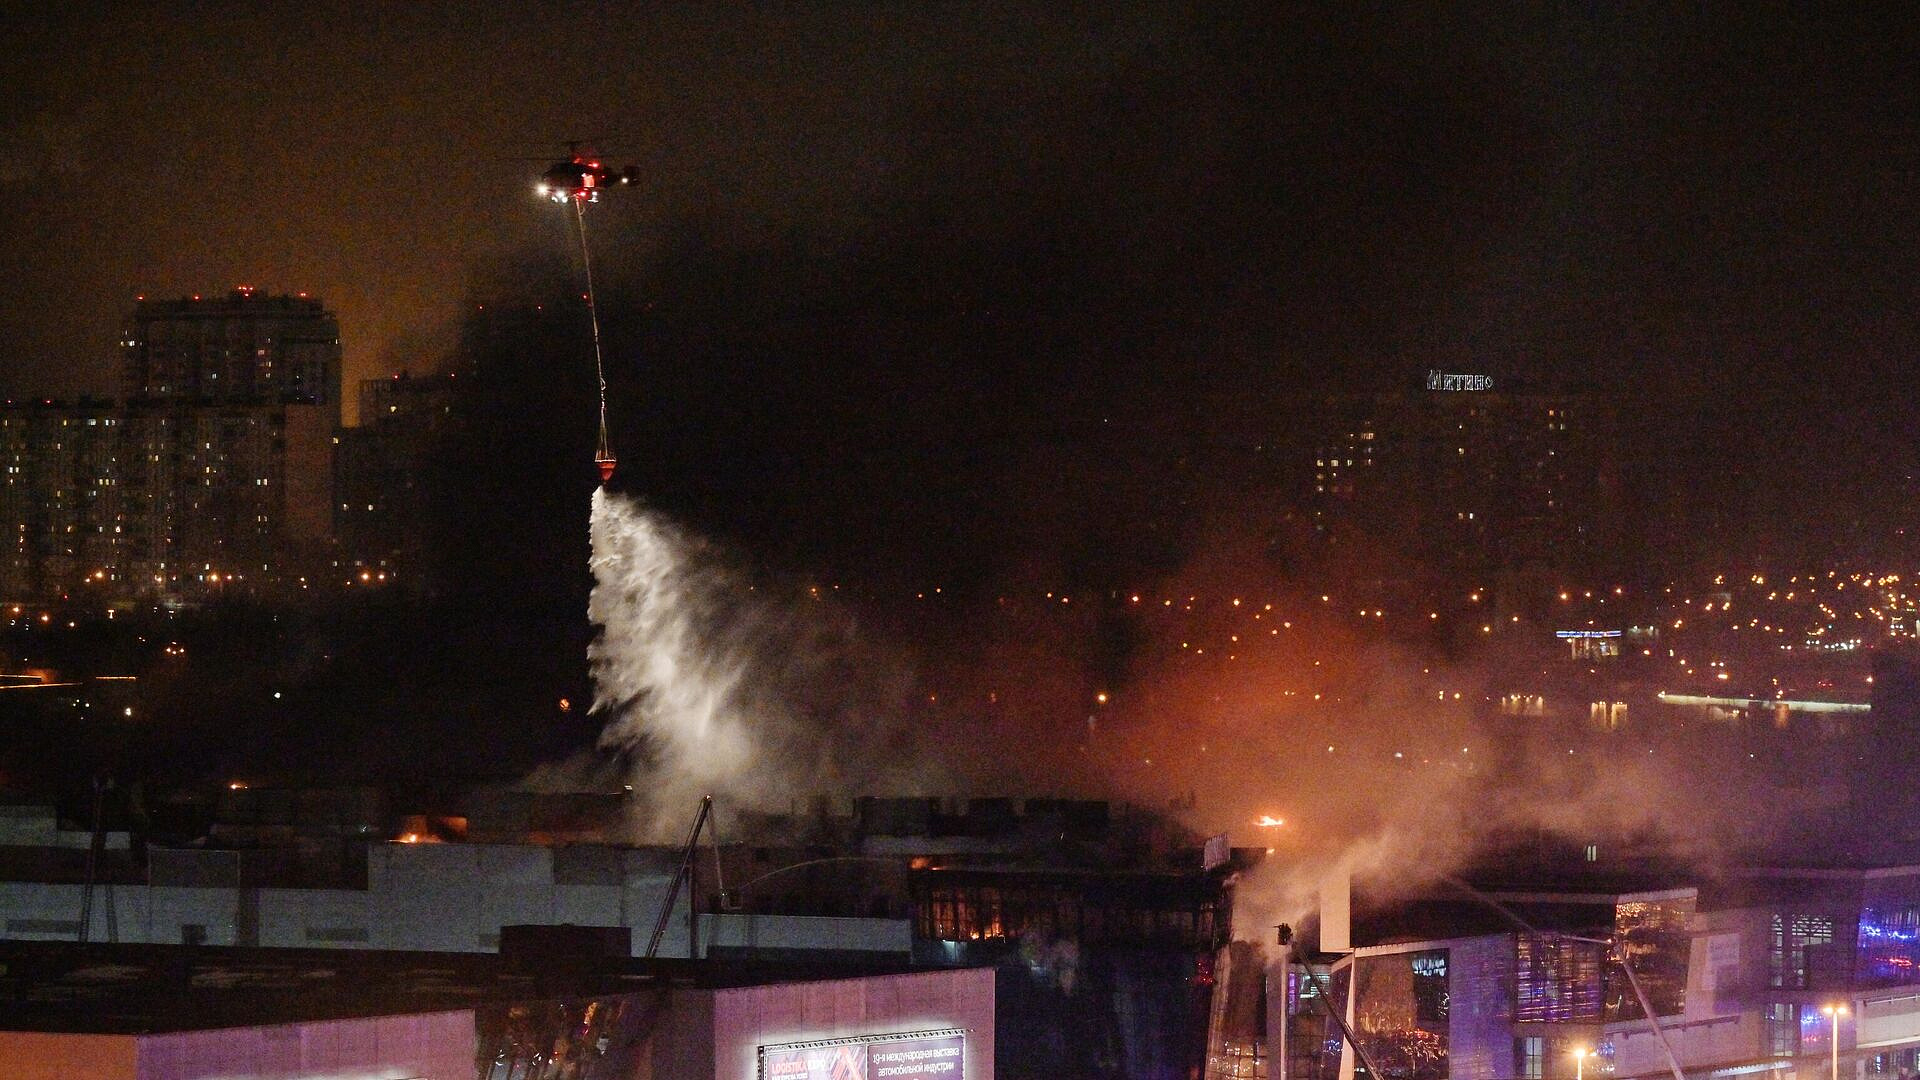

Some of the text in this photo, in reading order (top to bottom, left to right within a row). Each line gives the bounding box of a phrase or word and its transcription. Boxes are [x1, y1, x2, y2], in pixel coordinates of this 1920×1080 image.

[1426, 369, 1494, 391] Митино
[886, 1049, 932, 1064] международная
[933, 1047, 960, 1058] выставка
[771, 1061, 807, 1073] LOGISTIKA
[878, 1061, 955, 1077] автомобильной индустрии
